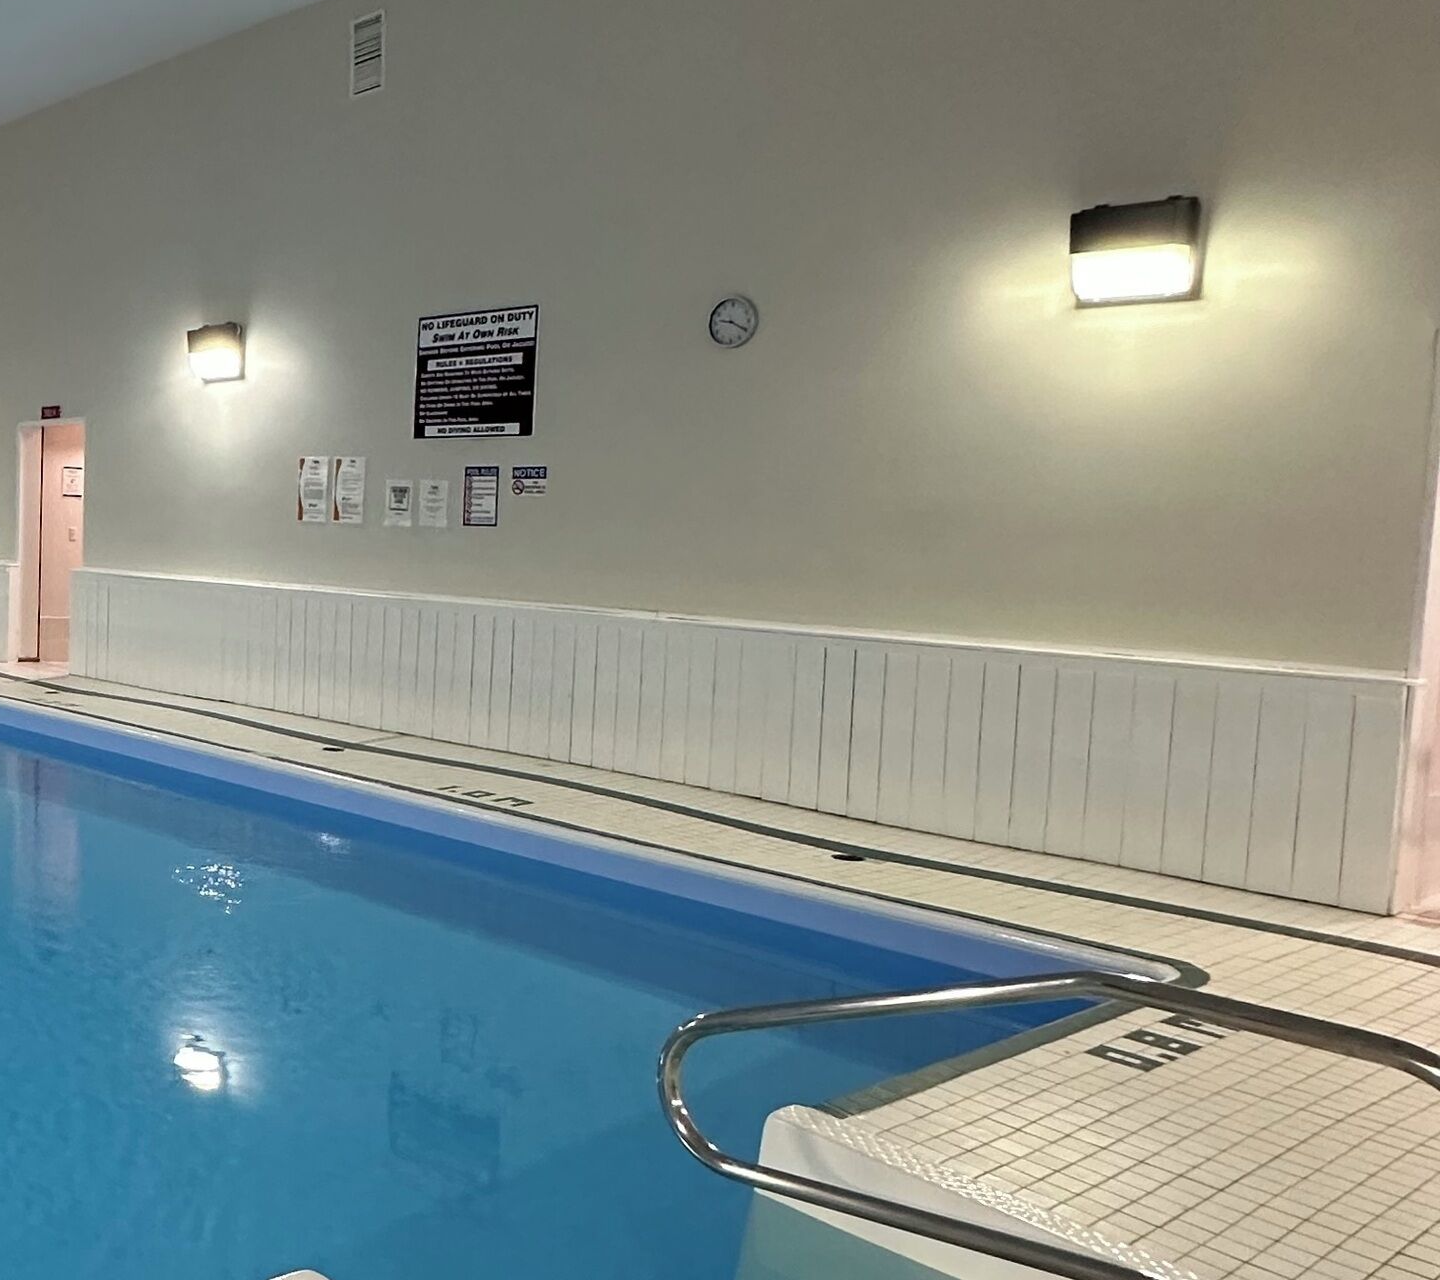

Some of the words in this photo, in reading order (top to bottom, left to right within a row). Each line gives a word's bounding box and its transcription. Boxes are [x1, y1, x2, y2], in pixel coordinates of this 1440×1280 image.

[421, 322, 435, 331] NO
[437, 315, 488, 330] LIFEGUARD
[490, 313, 505, 324] ON
[507, 310, 534, 322] DUTY
[513, 468, 546, 478] NOTICE
